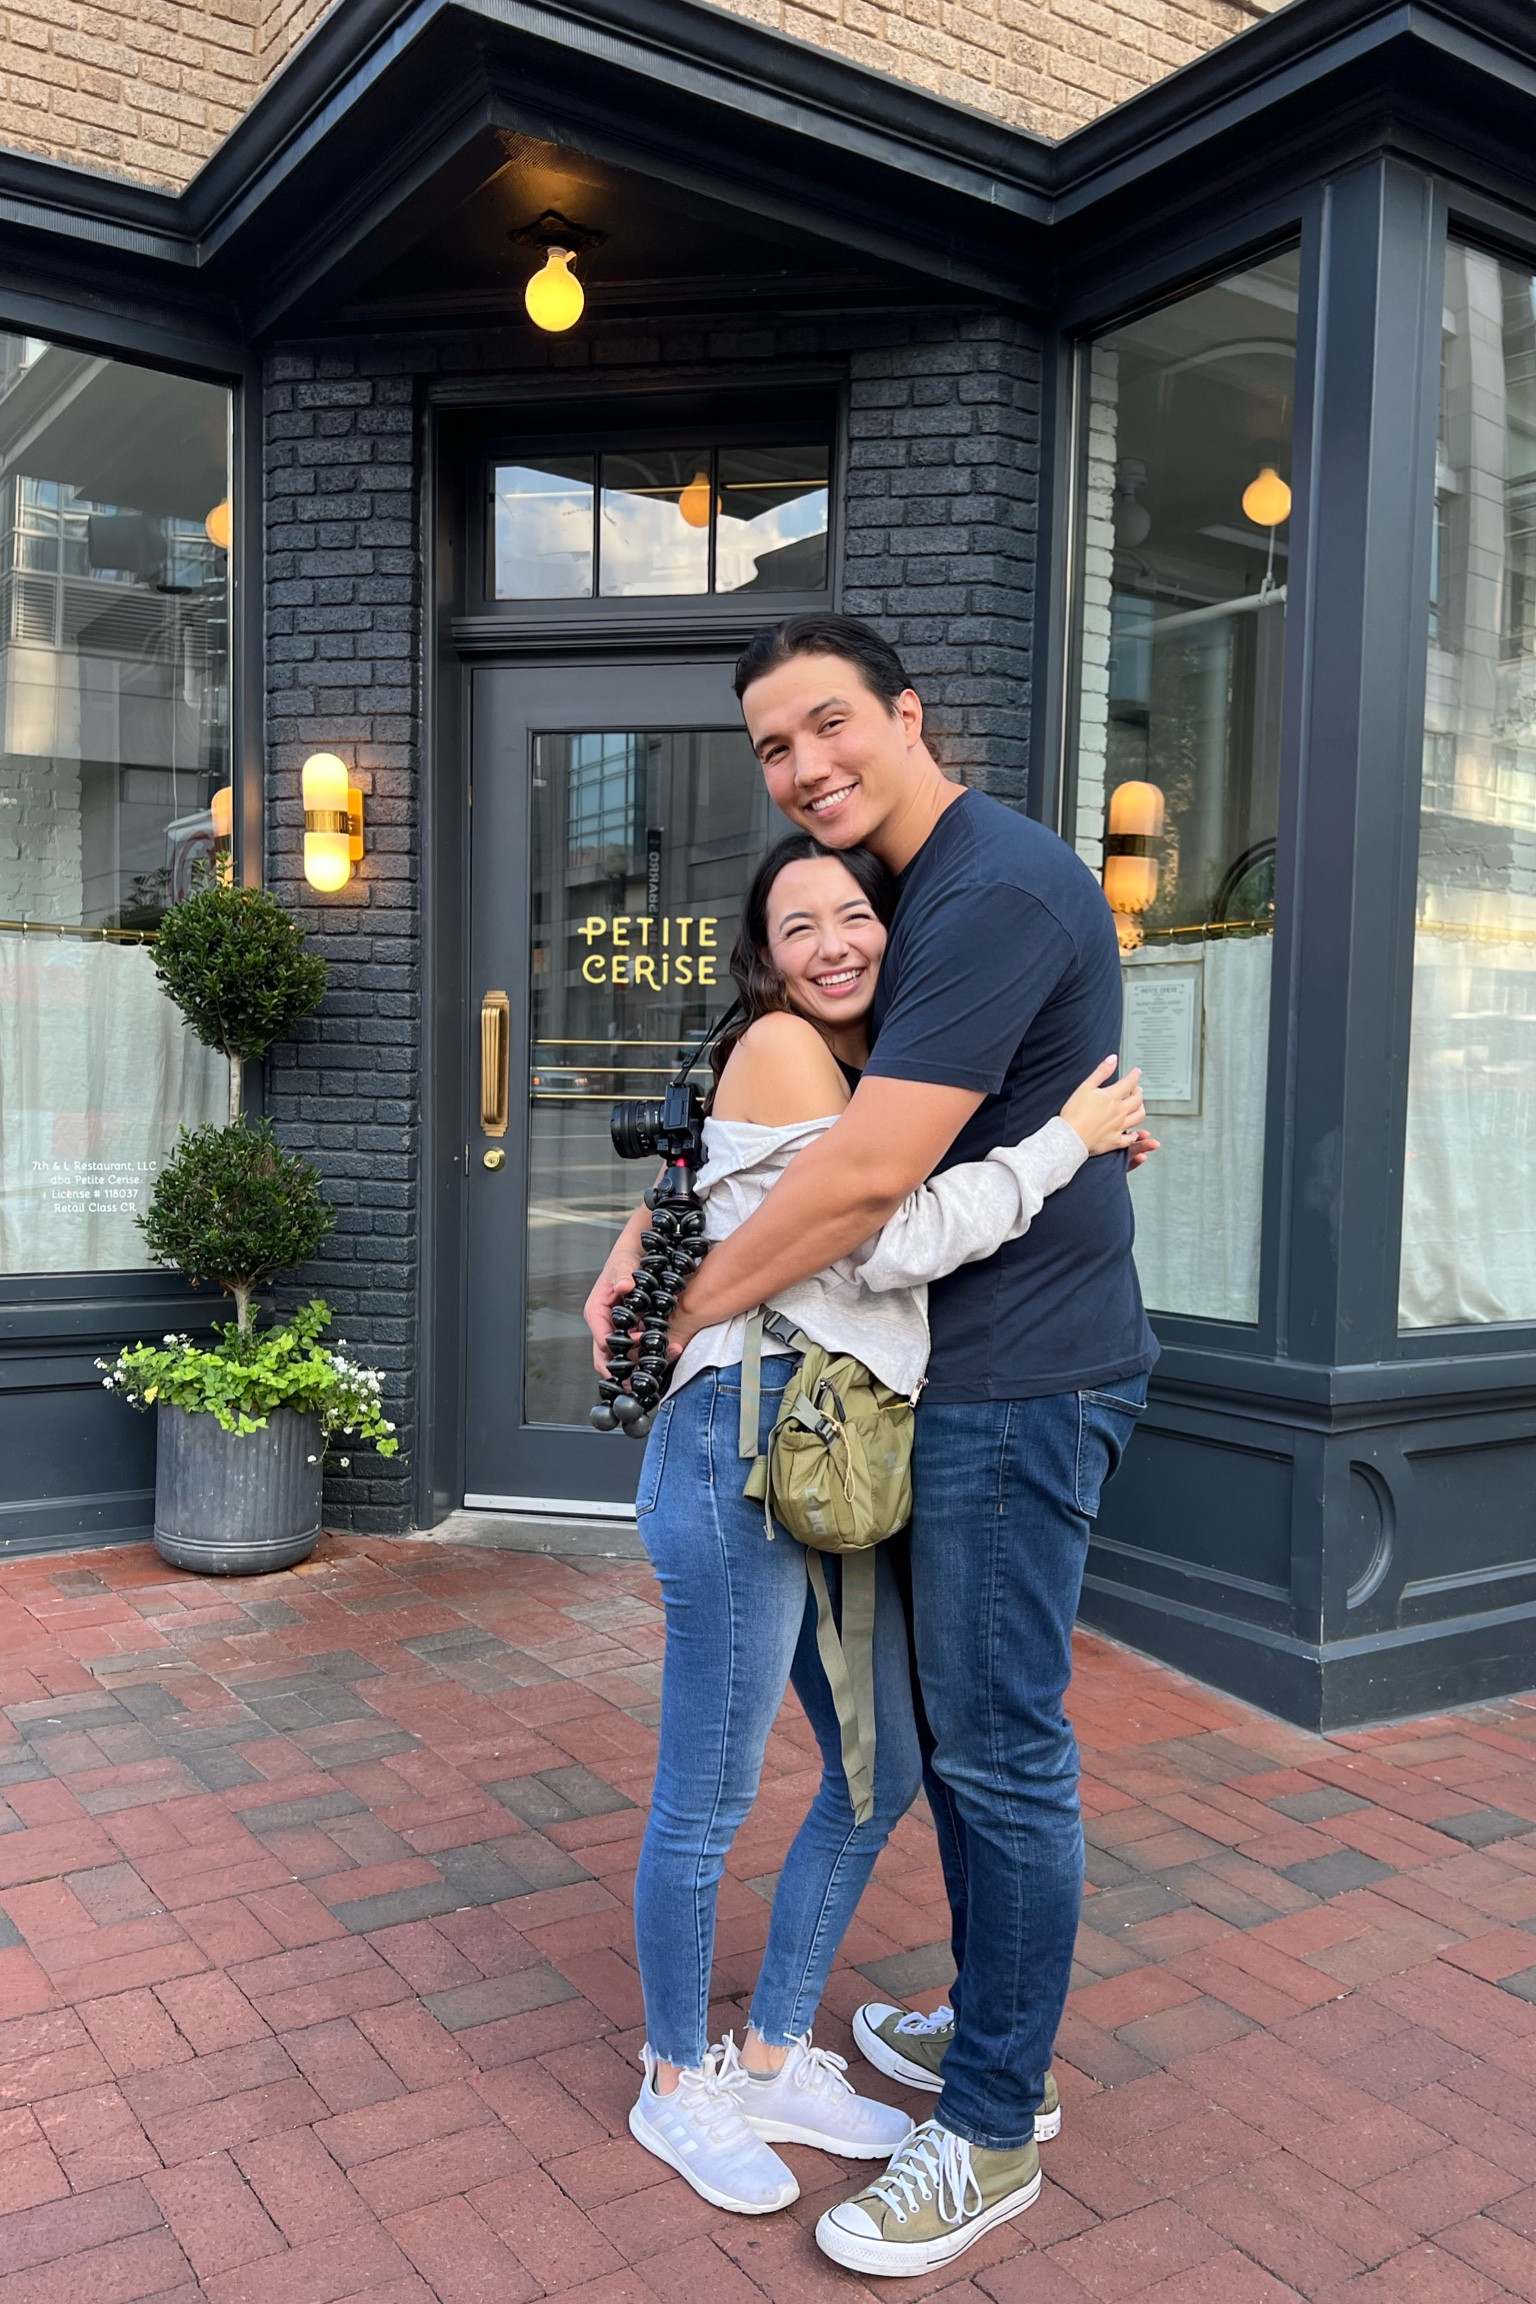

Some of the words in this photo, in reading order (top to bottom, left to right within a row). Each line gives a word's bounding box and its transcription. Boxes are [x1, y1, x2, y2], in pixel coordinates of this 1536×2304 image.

[577, 916, 718, 947] PETITE
[32, 1161, 50, 1171] 7th
[53, 1161, 60, 1171] &
[74, 1161, 135, 1172] Restaurant,
[137, 1161, 157, 1171] LLC
[51, 1174, 71, 1185] dba
[75, 1174, 105, 1185] Petite
[108, 1174, 140, 1185] Cerise
[52, 1188, 91, 1199] License
[94, 1189, 101, 1198] #
[104, 1188, 139, 1198] 118037
[54, 1202, 85, 1213] Retail
[89, 1202, 117, 1213] Class
[121, 1202, 137, 1213] CR
